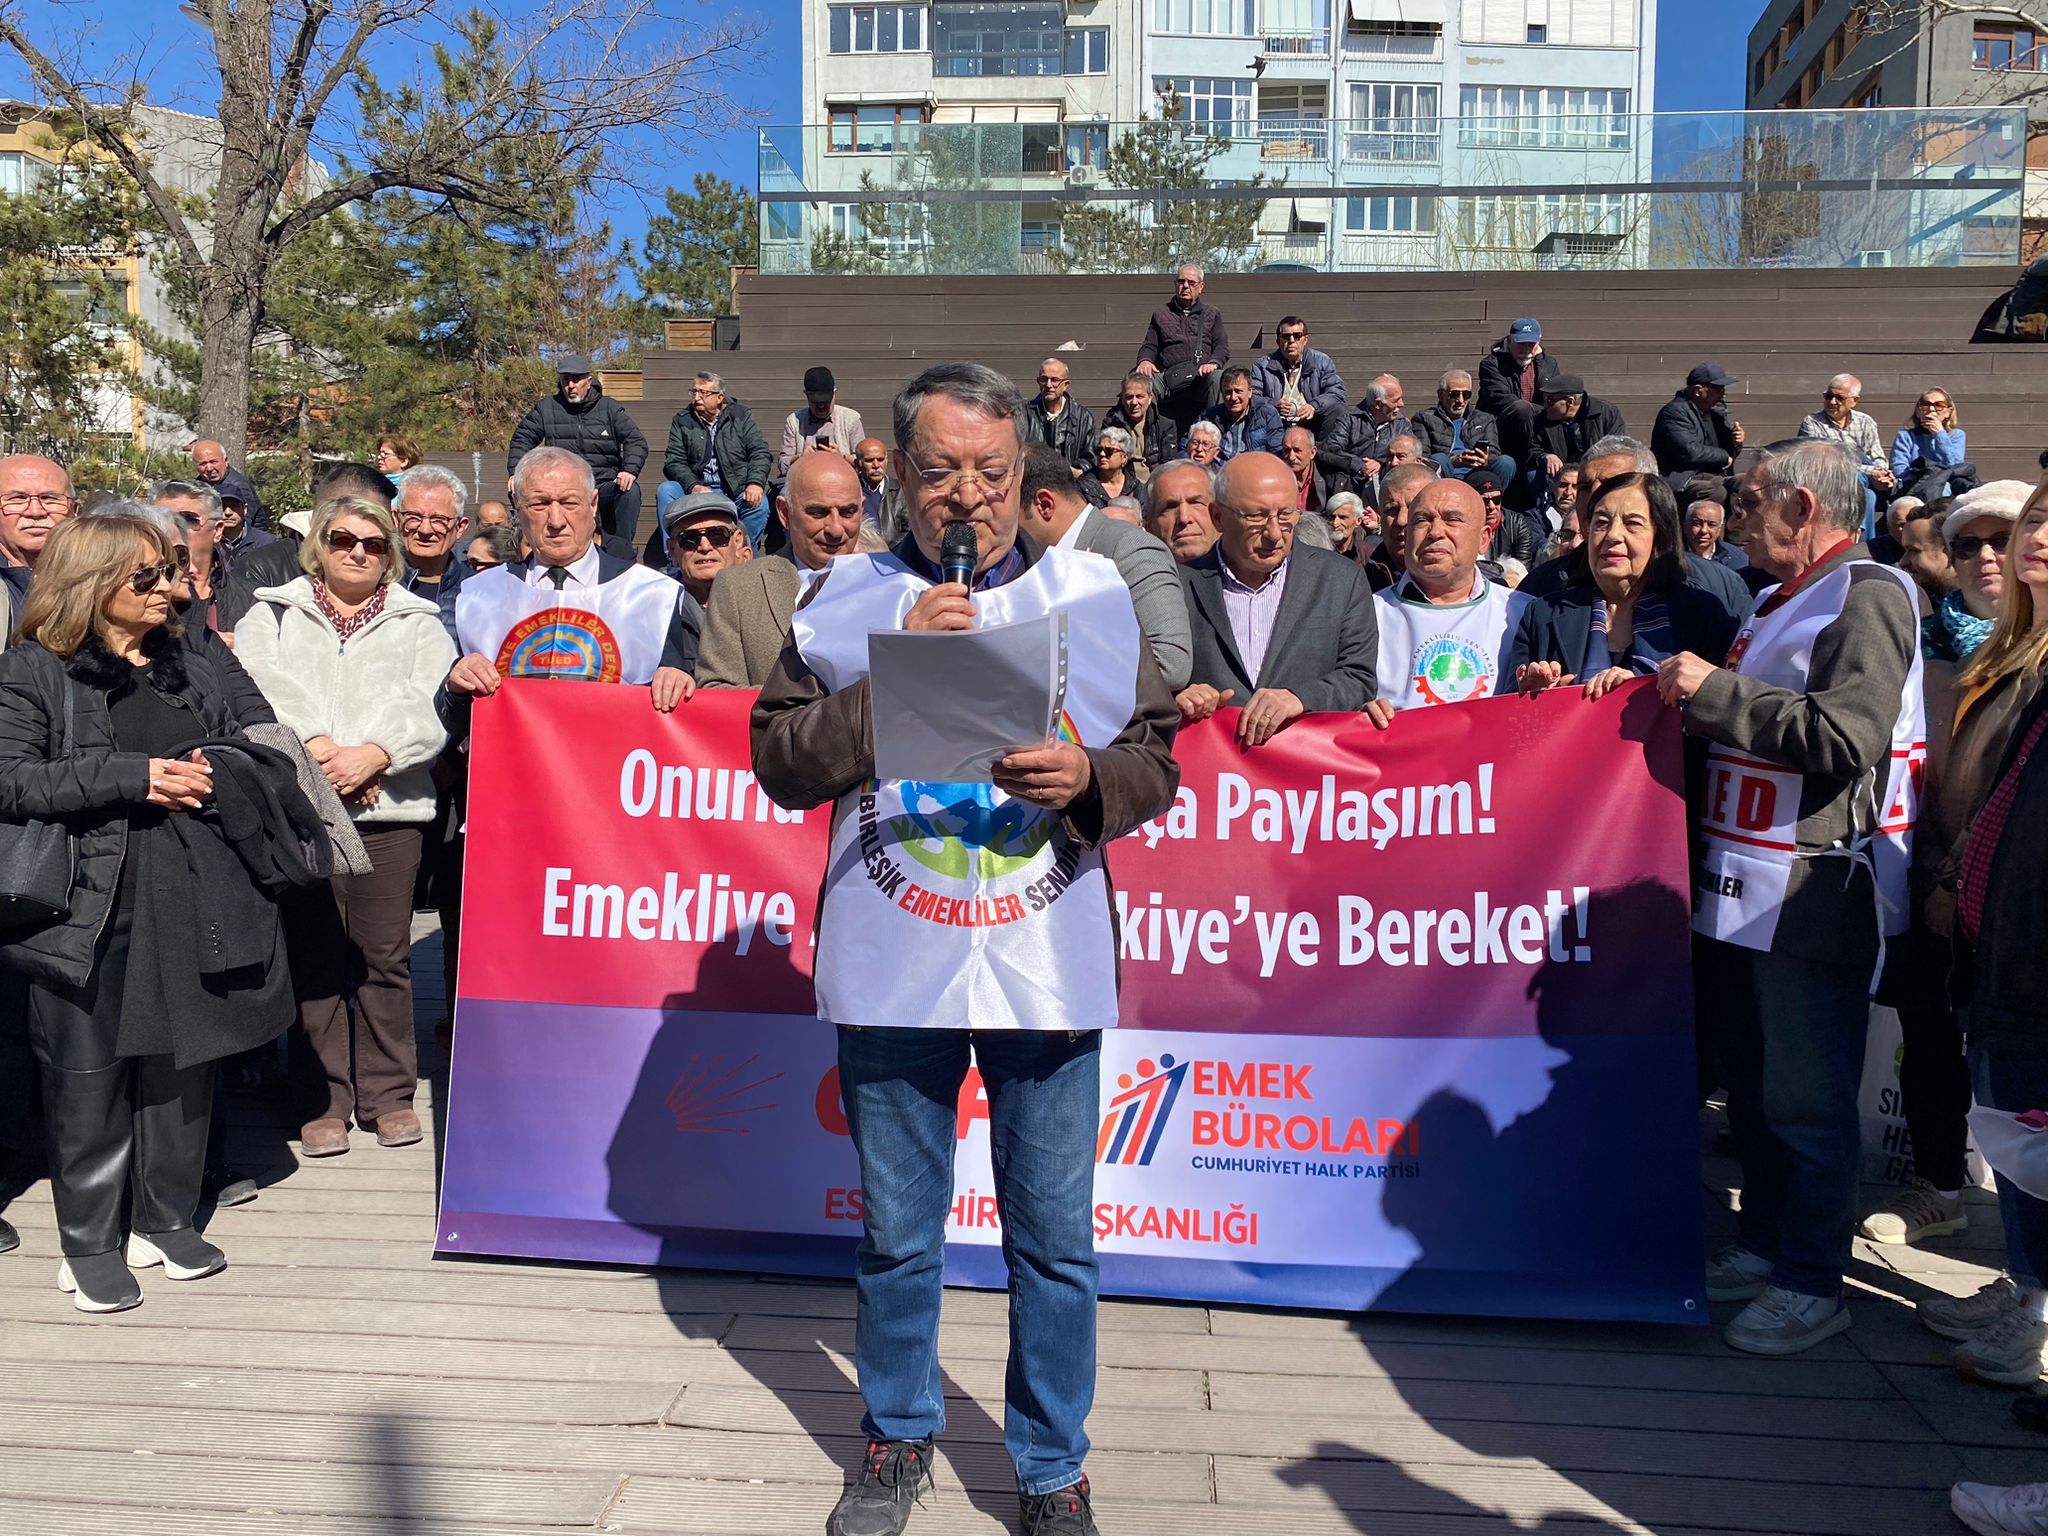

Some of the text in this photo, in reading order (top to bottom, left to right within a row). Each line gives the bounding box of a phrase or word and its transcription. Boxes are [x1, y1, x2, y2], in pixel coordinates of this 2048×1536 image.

[515, 611, 605, 638] EMEKLİLER
[1216, 763, 1496, 854] Paylaşım!
[1701, 768, 1777, 832] ED
[859, 794, 1081, 928] BİRLEŞİK EMEKLİLER SENDİK
[542, 867, 1592, 977] Emekliye kiye’ye Bereket!
[1193, 1060, 1313, 1100] EMEK
[1192, 1102, 1420, 1156] BÜROLARI
[1192, 1155, 1420, 1178] CUMHURİYET HALK PARTİSİ
[1094, 1203, 1258, 1245] ŞKANLIĞI
